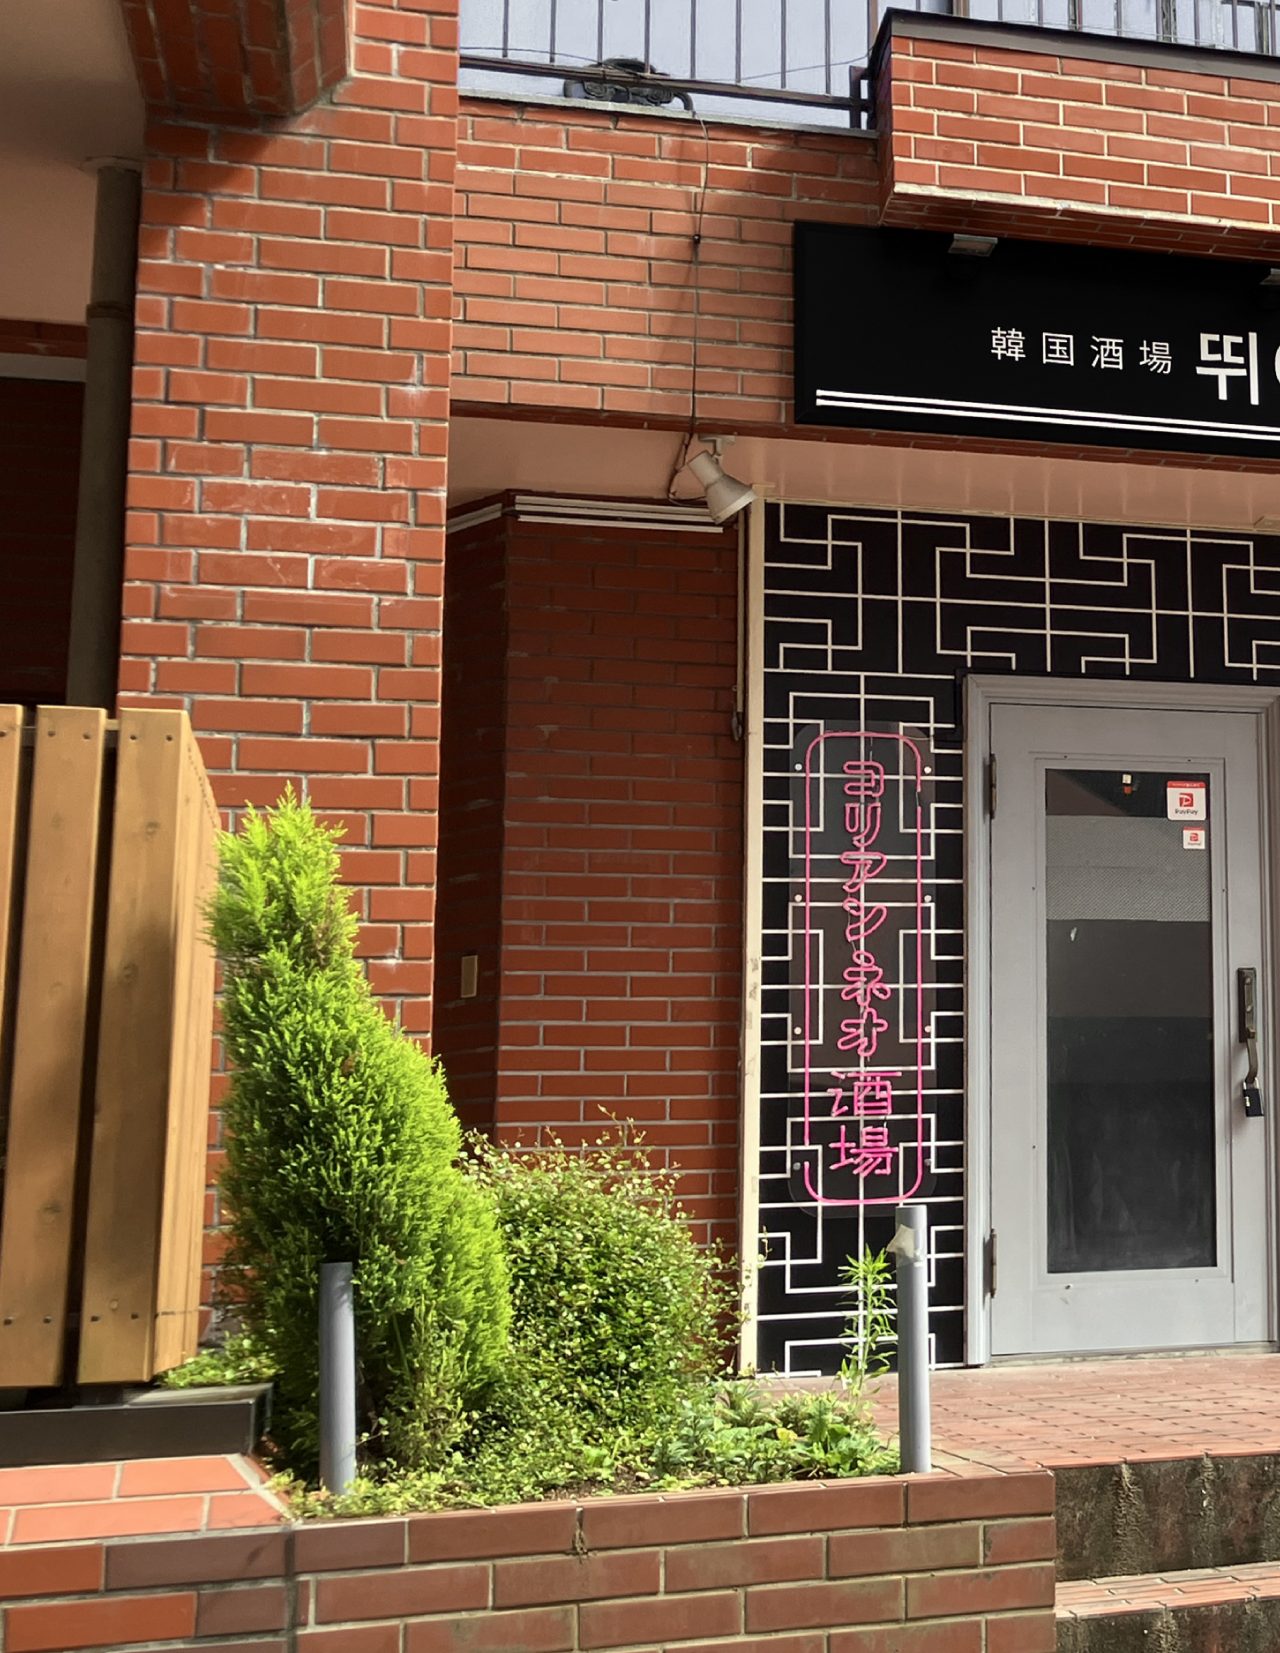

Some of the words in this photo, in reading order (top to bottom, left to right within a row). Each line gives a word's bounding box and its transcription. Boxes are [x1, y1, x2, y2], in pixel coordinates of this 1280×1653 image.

[990, 326, 1173, 374] 韓国酒場
[826, 759, 903, 1180] ヨリアンネオ酒場
